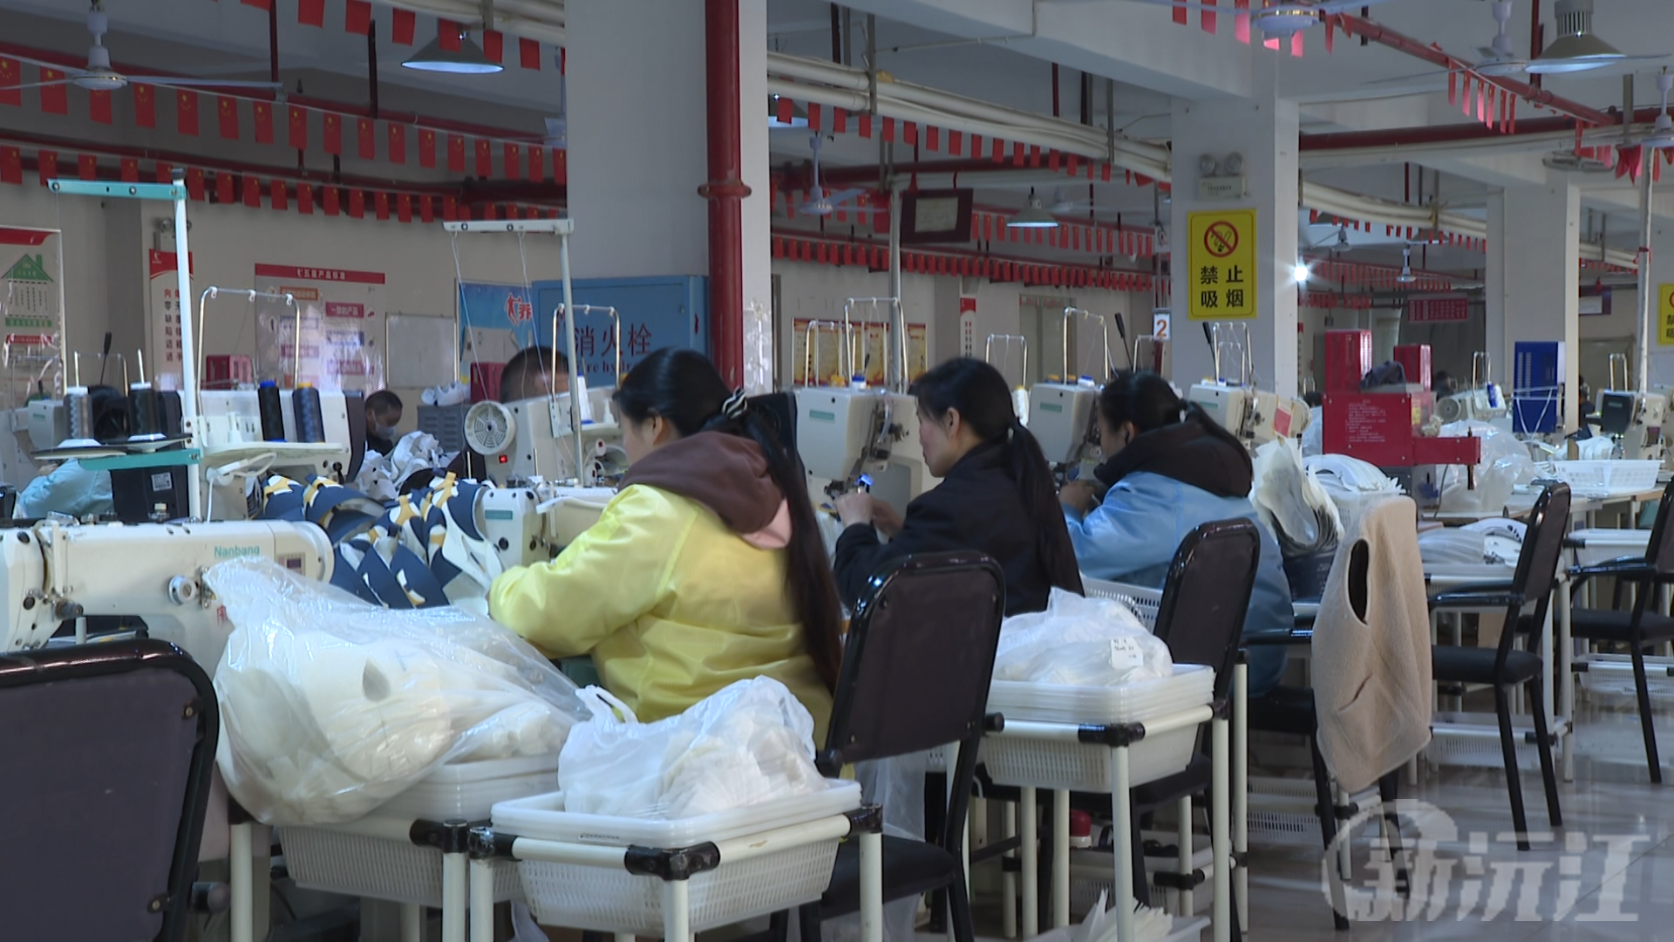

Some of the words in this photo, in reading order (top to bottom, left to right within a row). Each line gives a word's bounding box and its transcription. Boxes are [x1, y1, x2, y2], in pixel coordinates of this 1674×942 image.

[1200, 265, 1244, 285] 禁止
[1200, 288, 1244, 309] 吸烟
[1156, 319, 1168, 338] 2
[574, 322, 652, 357] 消火栓
